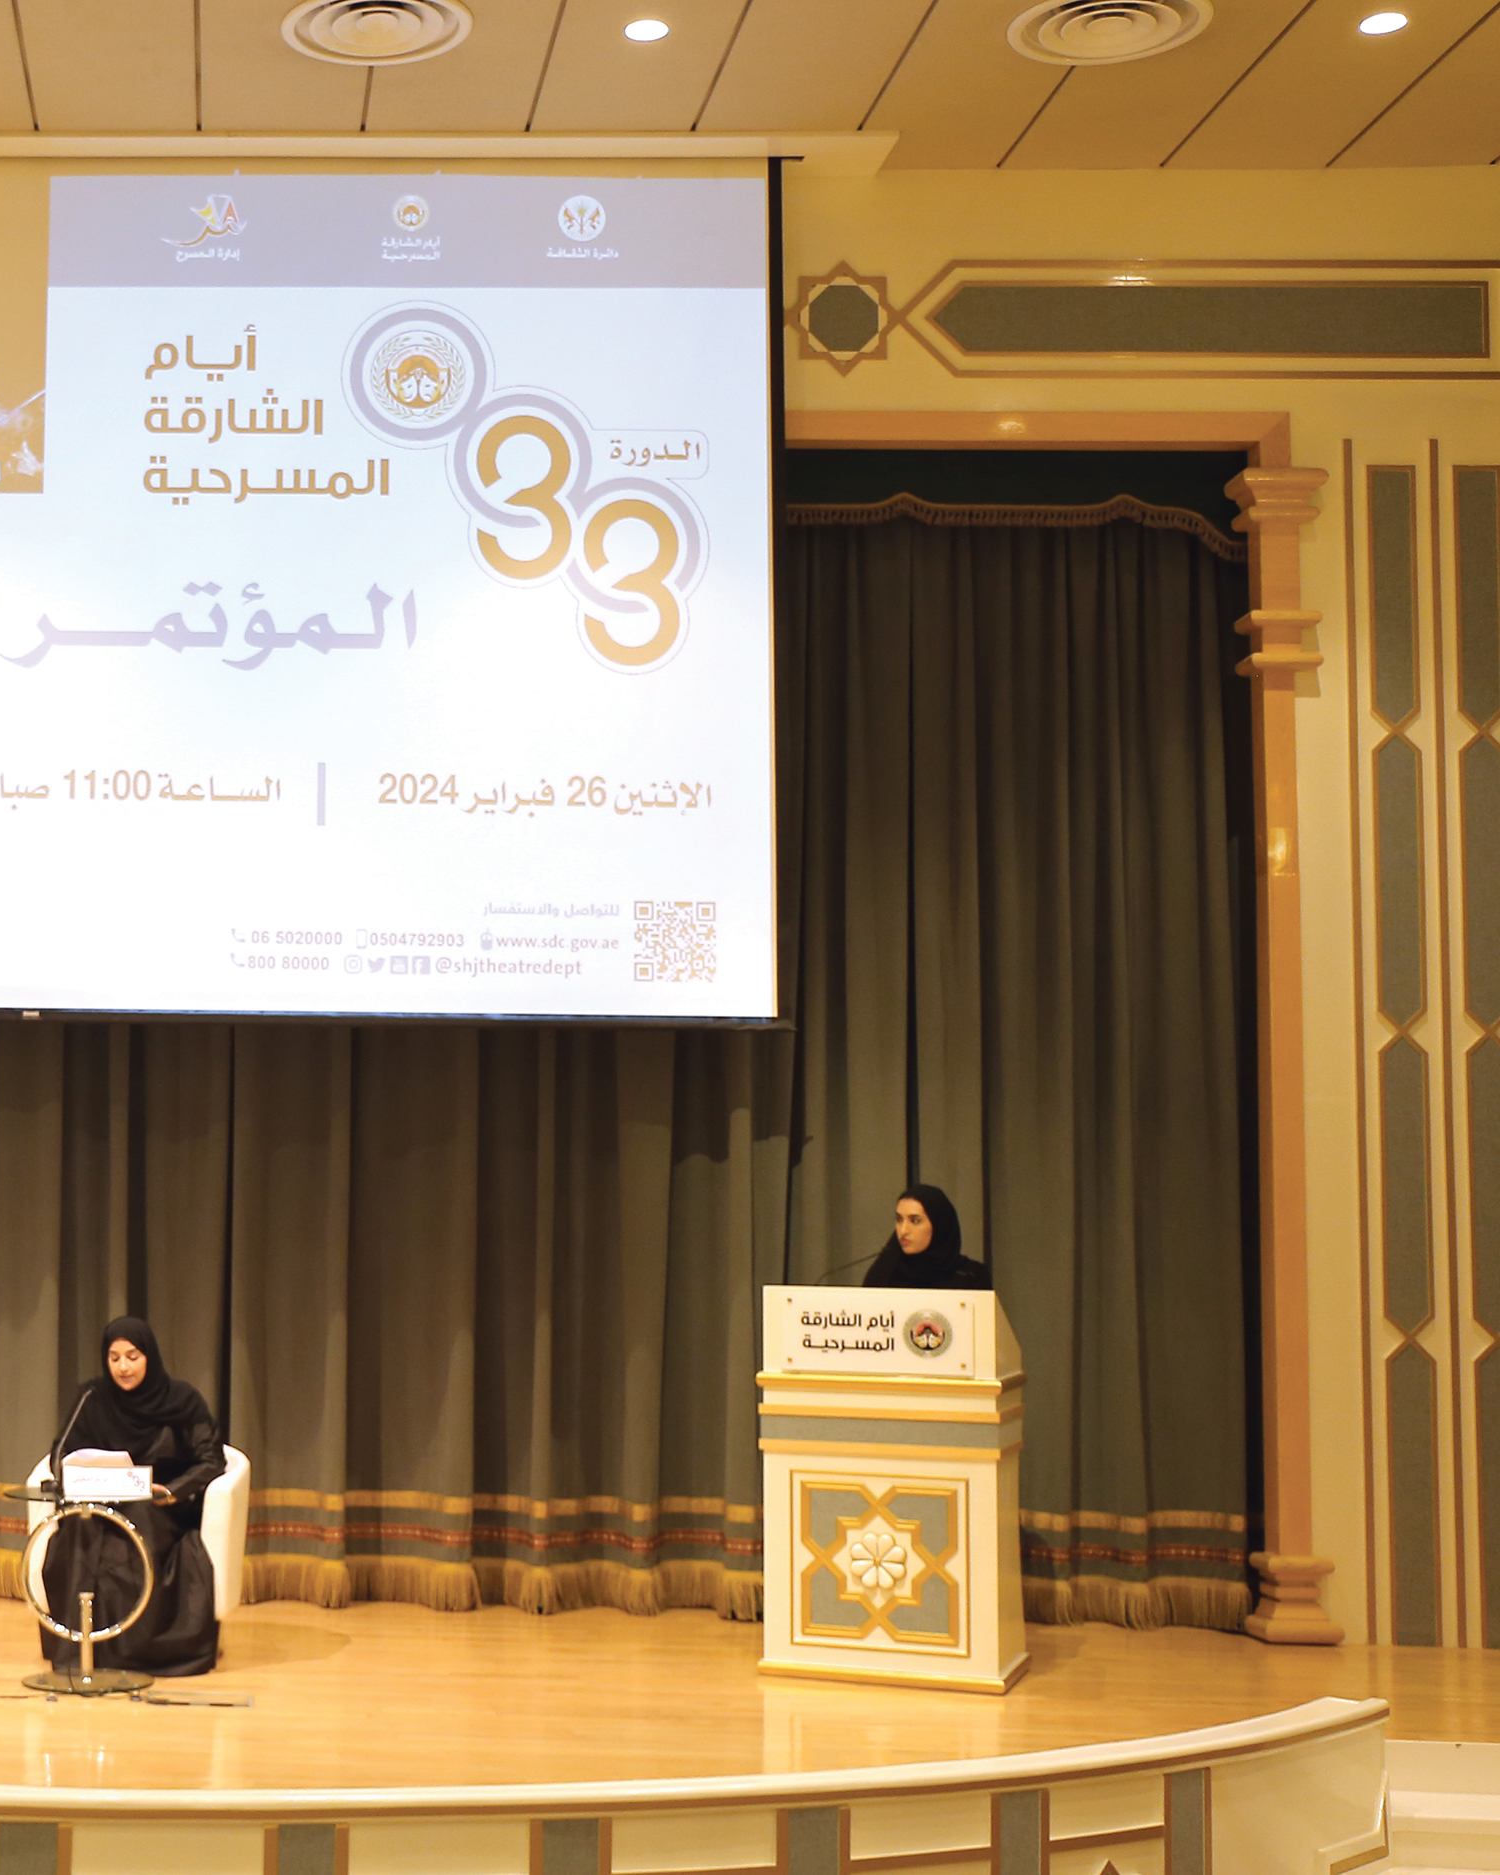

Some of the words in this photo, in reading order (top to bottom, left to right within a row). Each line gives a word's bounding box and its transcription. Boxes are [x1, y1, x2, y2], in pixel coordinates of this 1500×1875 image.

[145, 324, 257, 381] أيام
[144, 388, 324, 443] الشارقة
[610, 440, 700, 467] الدورة
[143, 456, 390, 505] المسرحية
[63, 769, 151, 801] 11:00
[157, 773, 281, 802] الساعة
[378, 772, 460, 804] 2024
[566, 775, 607, 807] 26
[461, 778, 556, 818] فبراير
[482, 902, 560, 917] والاستفسار
[564, 903, 619, 918] للتواصل
[251, 930, 270, 944] 06
[276, 930, 343, 945] 5020000
[369, 932, 465, 947] 0504792903
[496, 935, 620, 952] www.sdc.gov.ae
[247, 955, 276, 970] 800
[282, 956, 330, 970] 80000
[435, 957, 582, 979] @shjtheatredept
[800, 1309, 862, 1330] الشارقة
[865, 1310, 895, 1333] أيام
[802, 1333, 895, 1354] المسرحية
